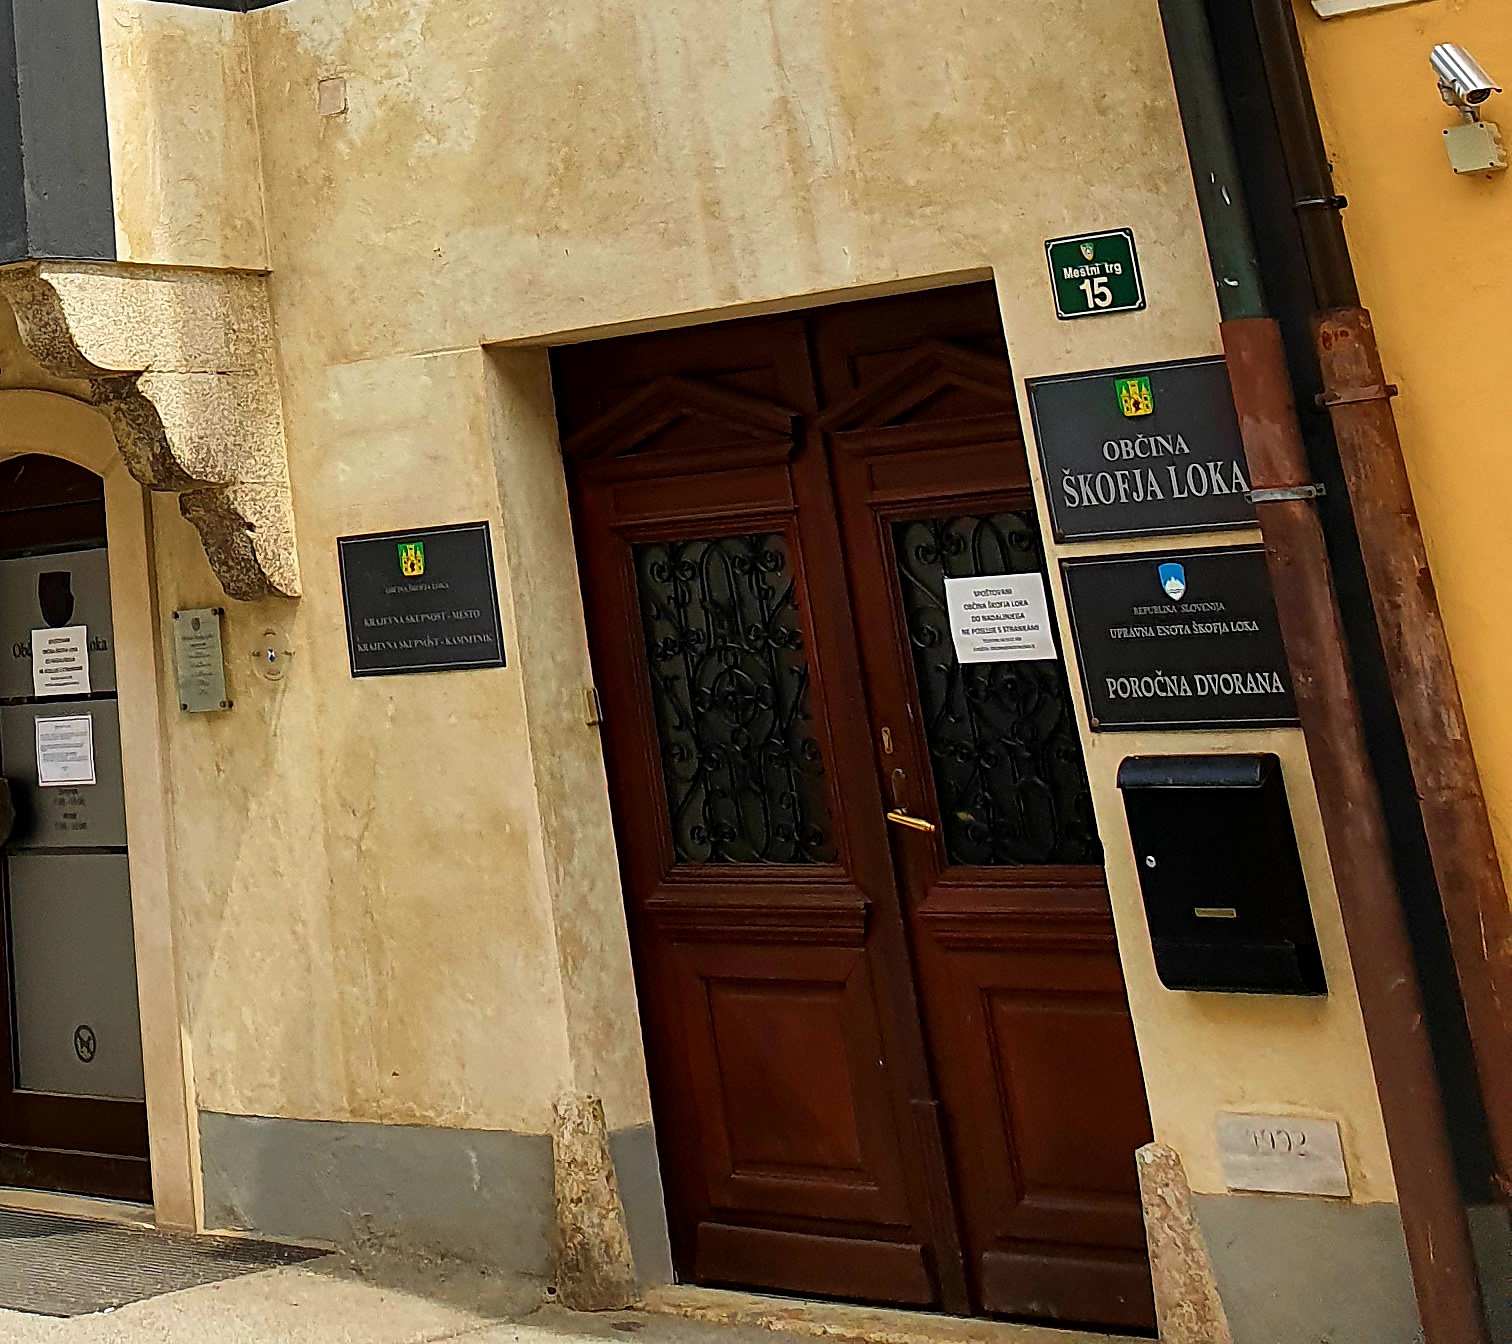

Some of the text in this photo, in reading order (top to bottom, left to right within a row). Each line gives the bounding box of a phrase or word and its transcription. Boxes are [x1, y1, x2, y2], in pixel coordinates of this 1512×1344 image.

[1063, 262, 1123, 279] Mestni trg
[1079, 276, 1113, 309] 15
[1102, 433, 1190, 462] OBČINA
[1061, 460, 1251, 508] ŠKOFJA LOKA
[1133, 602, 1225, 615] REPUBLIKA SLOVENIJA
[1109, 620, 1260, 639] UPRAVNA ENOTA ŠKOFJA LOKA
[89, 636, 108, 651] oka
[1106, 670, 1285, 699] POROČNA DVORANA
